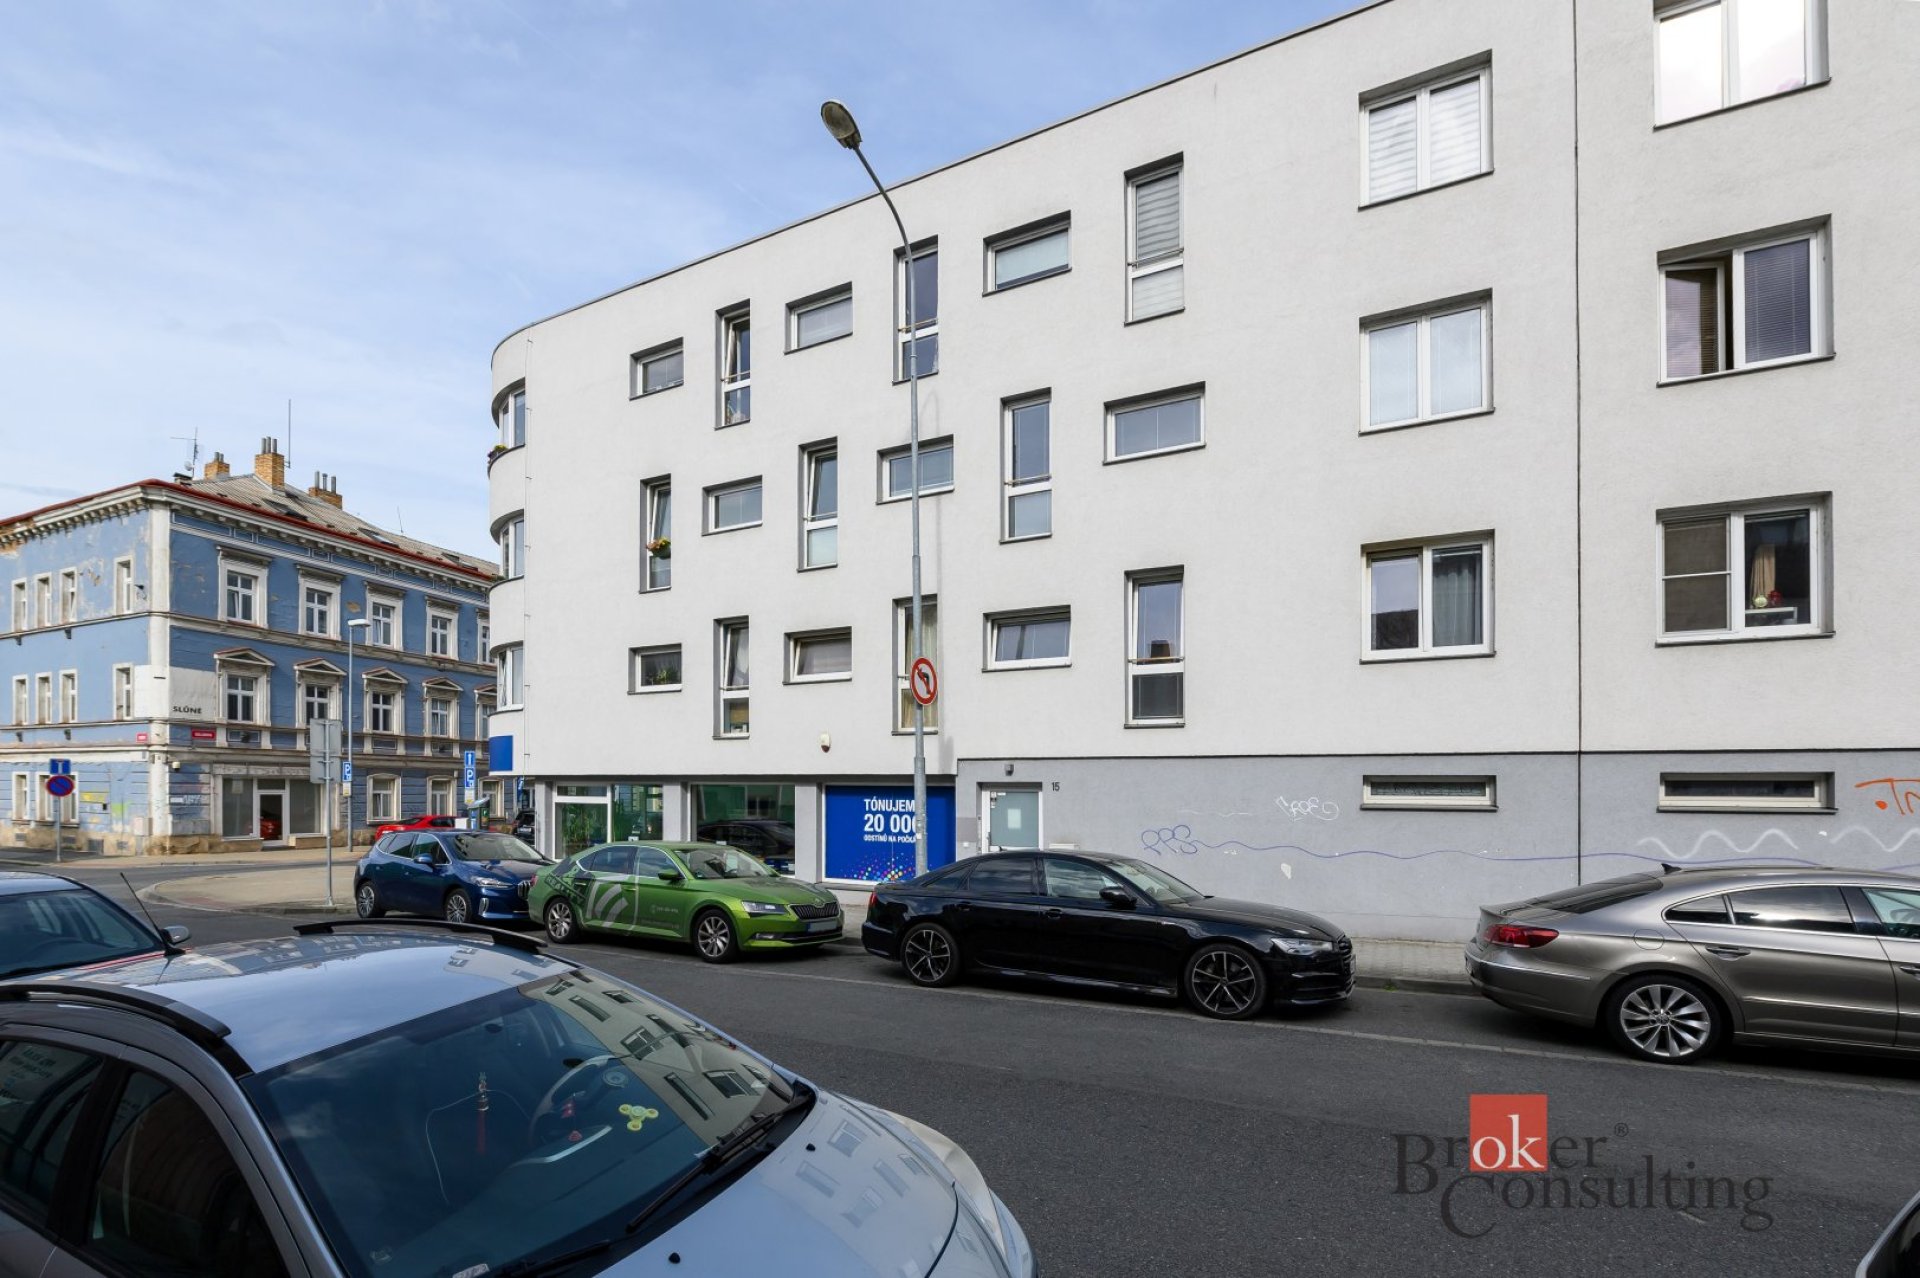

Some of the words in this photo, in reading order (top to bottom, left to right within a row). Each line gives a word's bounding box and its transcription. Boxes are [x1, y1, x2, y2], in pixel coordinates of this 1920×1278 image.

[1052, 781, 1061, 791] 15
[864, 796, 915, 812] TÓNUJEM
[864, 813, 885, 832] 20
[897, 834, 917, 844] POČKÁ
